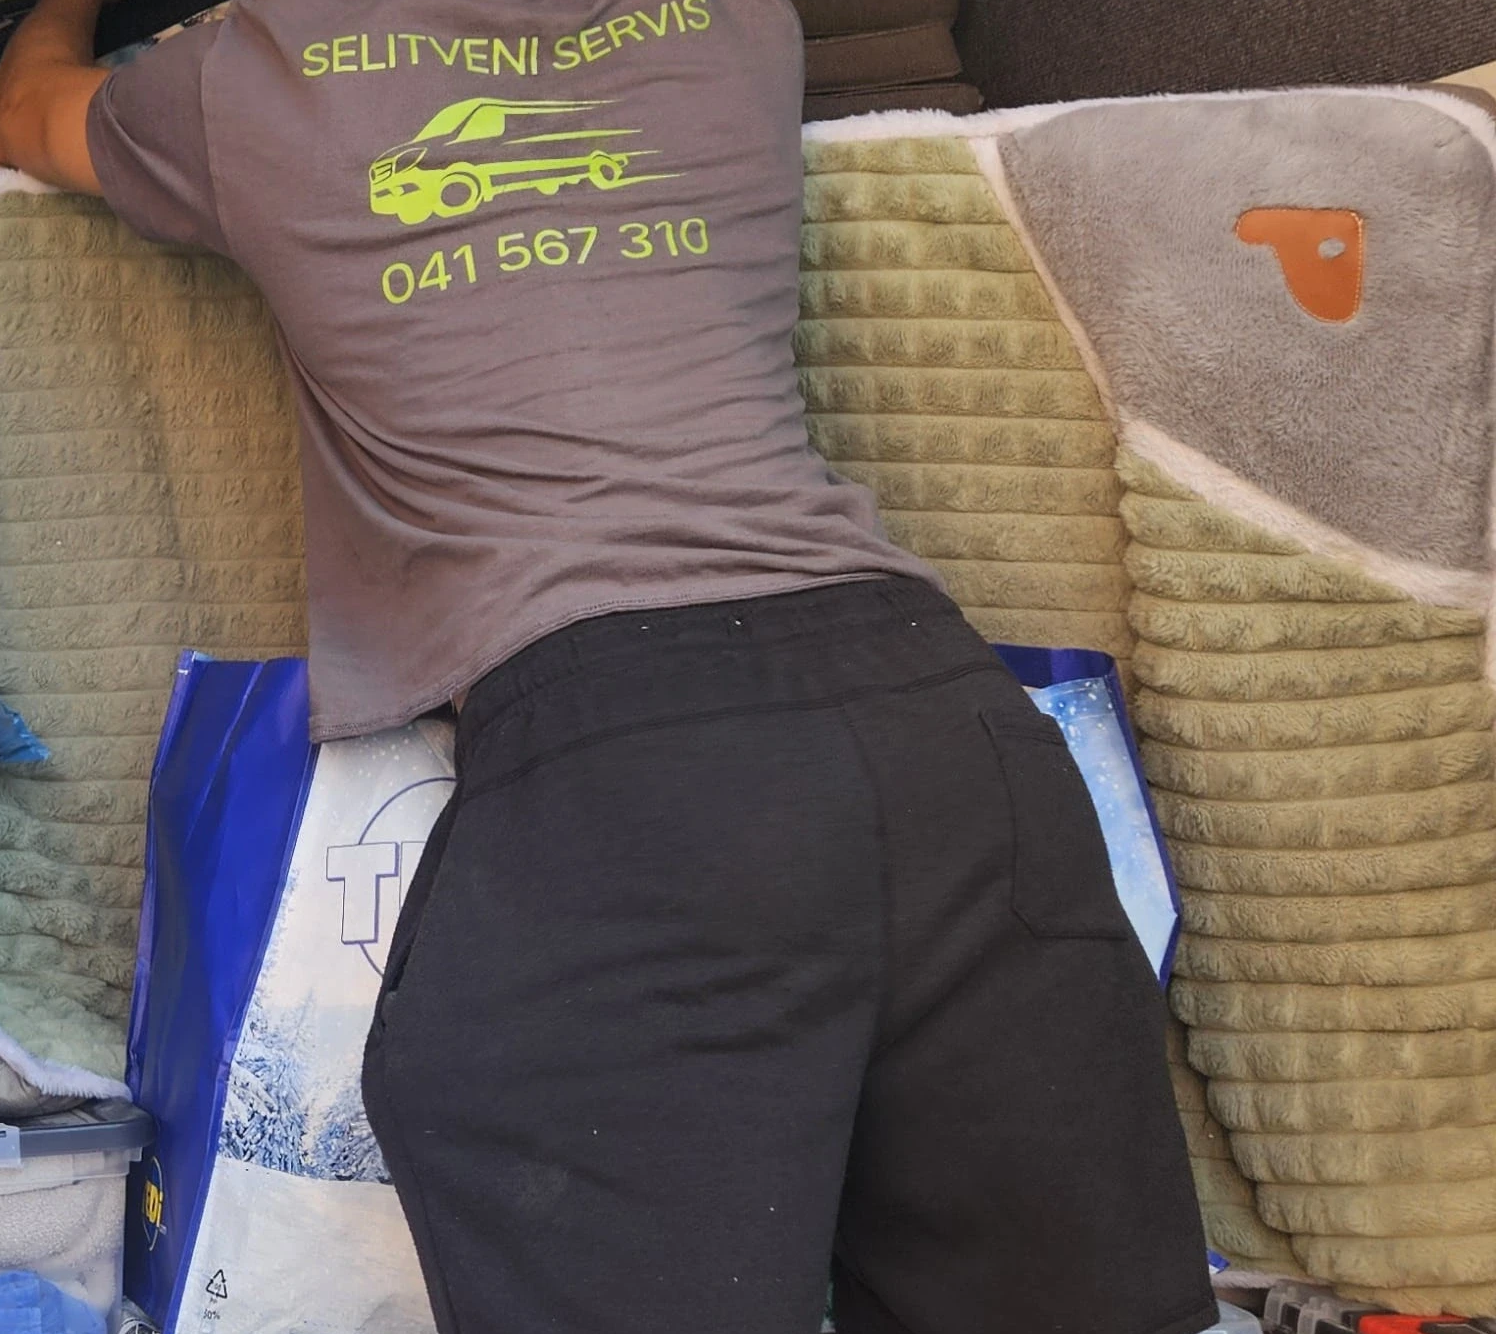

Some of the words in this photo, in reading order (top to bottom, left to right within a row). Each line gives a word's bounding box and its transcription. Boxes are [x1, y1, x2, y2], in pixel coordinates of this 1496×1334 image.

[302, 33, 539, 77] SELITVENI
[381, 244, 477, 304] 041
[497, 226, 599, 272] 567
[618, 217, 710, 259] 310
